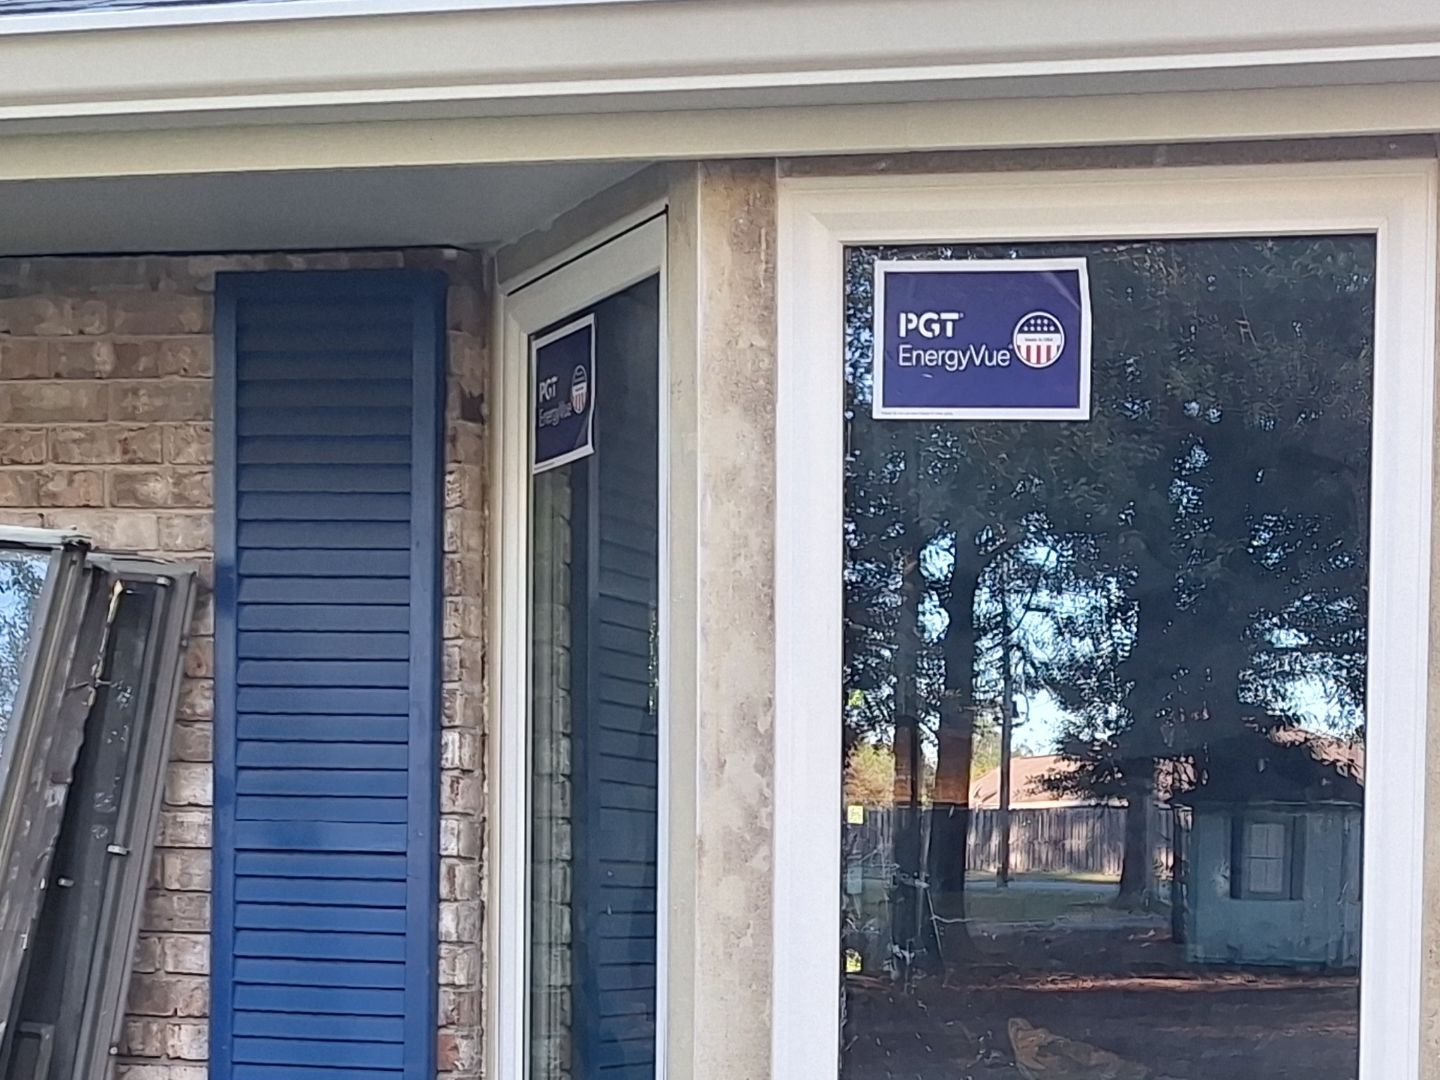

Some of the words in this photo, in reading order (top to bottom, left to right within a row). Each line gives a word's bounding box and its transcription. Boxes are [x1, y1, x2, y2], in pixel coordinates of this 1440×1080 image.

[899, 312, 960, 338] PGT
[898, 344, 1012, 371] EnergyVue
[539, 376, 558, 402] PGT
